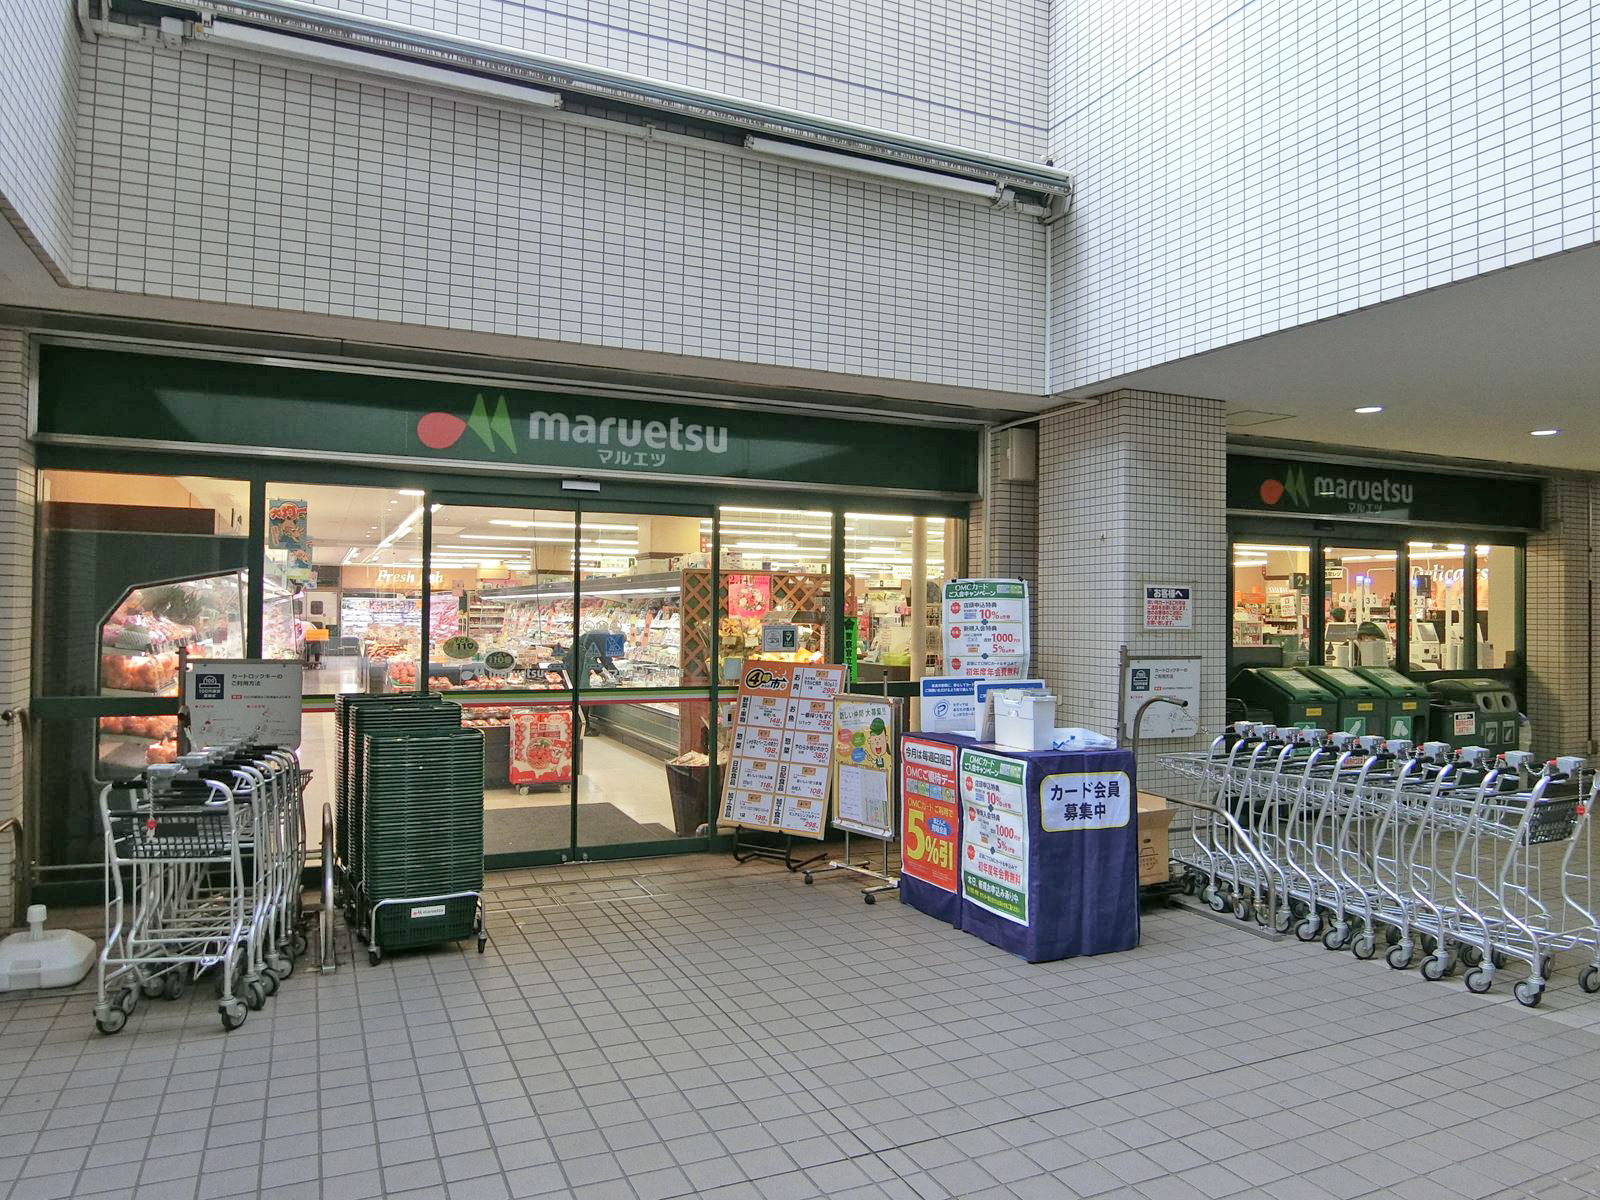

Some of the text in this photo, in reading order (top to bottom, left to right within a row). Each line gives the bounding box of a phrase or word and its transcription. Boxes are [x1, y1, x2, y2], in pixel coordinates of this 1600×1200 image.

[529, 410, 728, 454] maruetsu
[599, 450, 666, 466] マルエツ
[1314, 476, 1414, 503] maruetsu
[1348, 502, 1383, 514] マルエツ
[377, 569, 415, 583] Fresh
[1297, 575, 1304, 587] 2
[948, 590, 996, 598] ご入会キャンペーン
[955, 583, 989, 591] OMCカード
[1153, 588, 1184, 598] お客様へ
[991, 633, 1014, 643] 1000
[966, 667, 1020, 677] 初年度年会費無料
[905, 746, 952, 767] 今月は毎週日曜日
[969, 756, 995, 767] OMCカード
[964, 762, 999, 777] ご入会キャンペーン
[1050, 780, 1121, 801] カード会員
[1063, 801, 1106, 821] 募集中
[907, 807, 954, 871] 5%引
[995, 824, 1014, 840] 1000
[977, 861, 1021, 886] 初年度年会費無料
